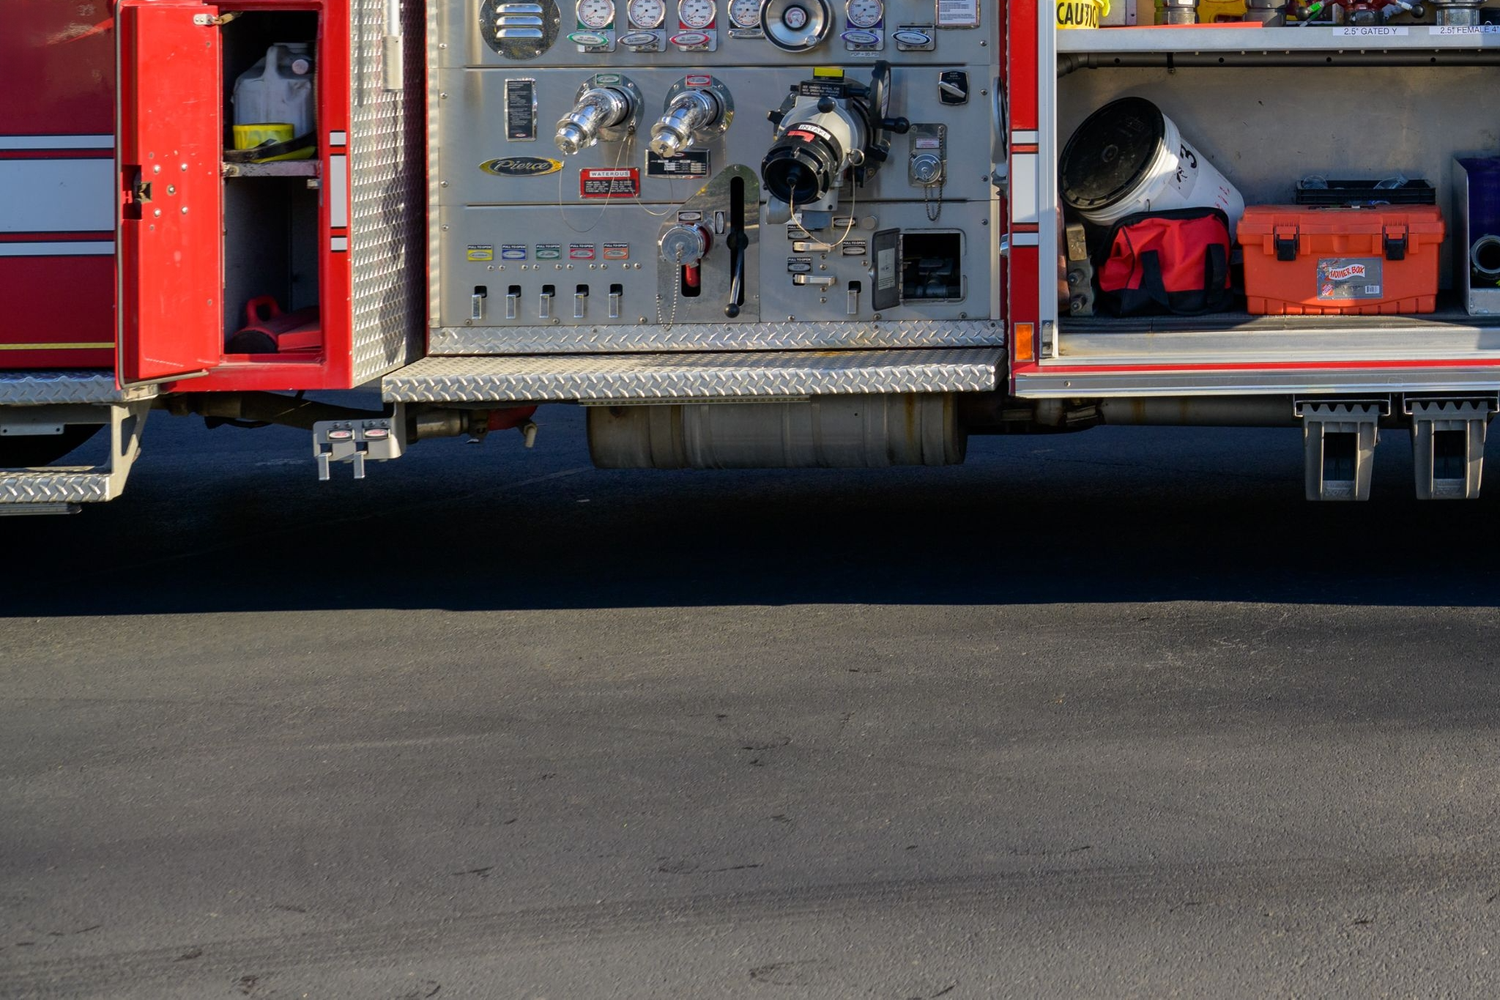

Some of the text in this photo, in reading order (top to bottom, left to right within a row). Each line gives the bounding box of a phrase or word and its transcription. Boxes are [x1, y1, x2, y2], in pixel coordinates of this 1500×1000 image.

[1456, 26, 1490, 34] FEMALE
[494, 160, 550, 170] Pierce
[1330, 265, 1365, 279] HOMER BOX
